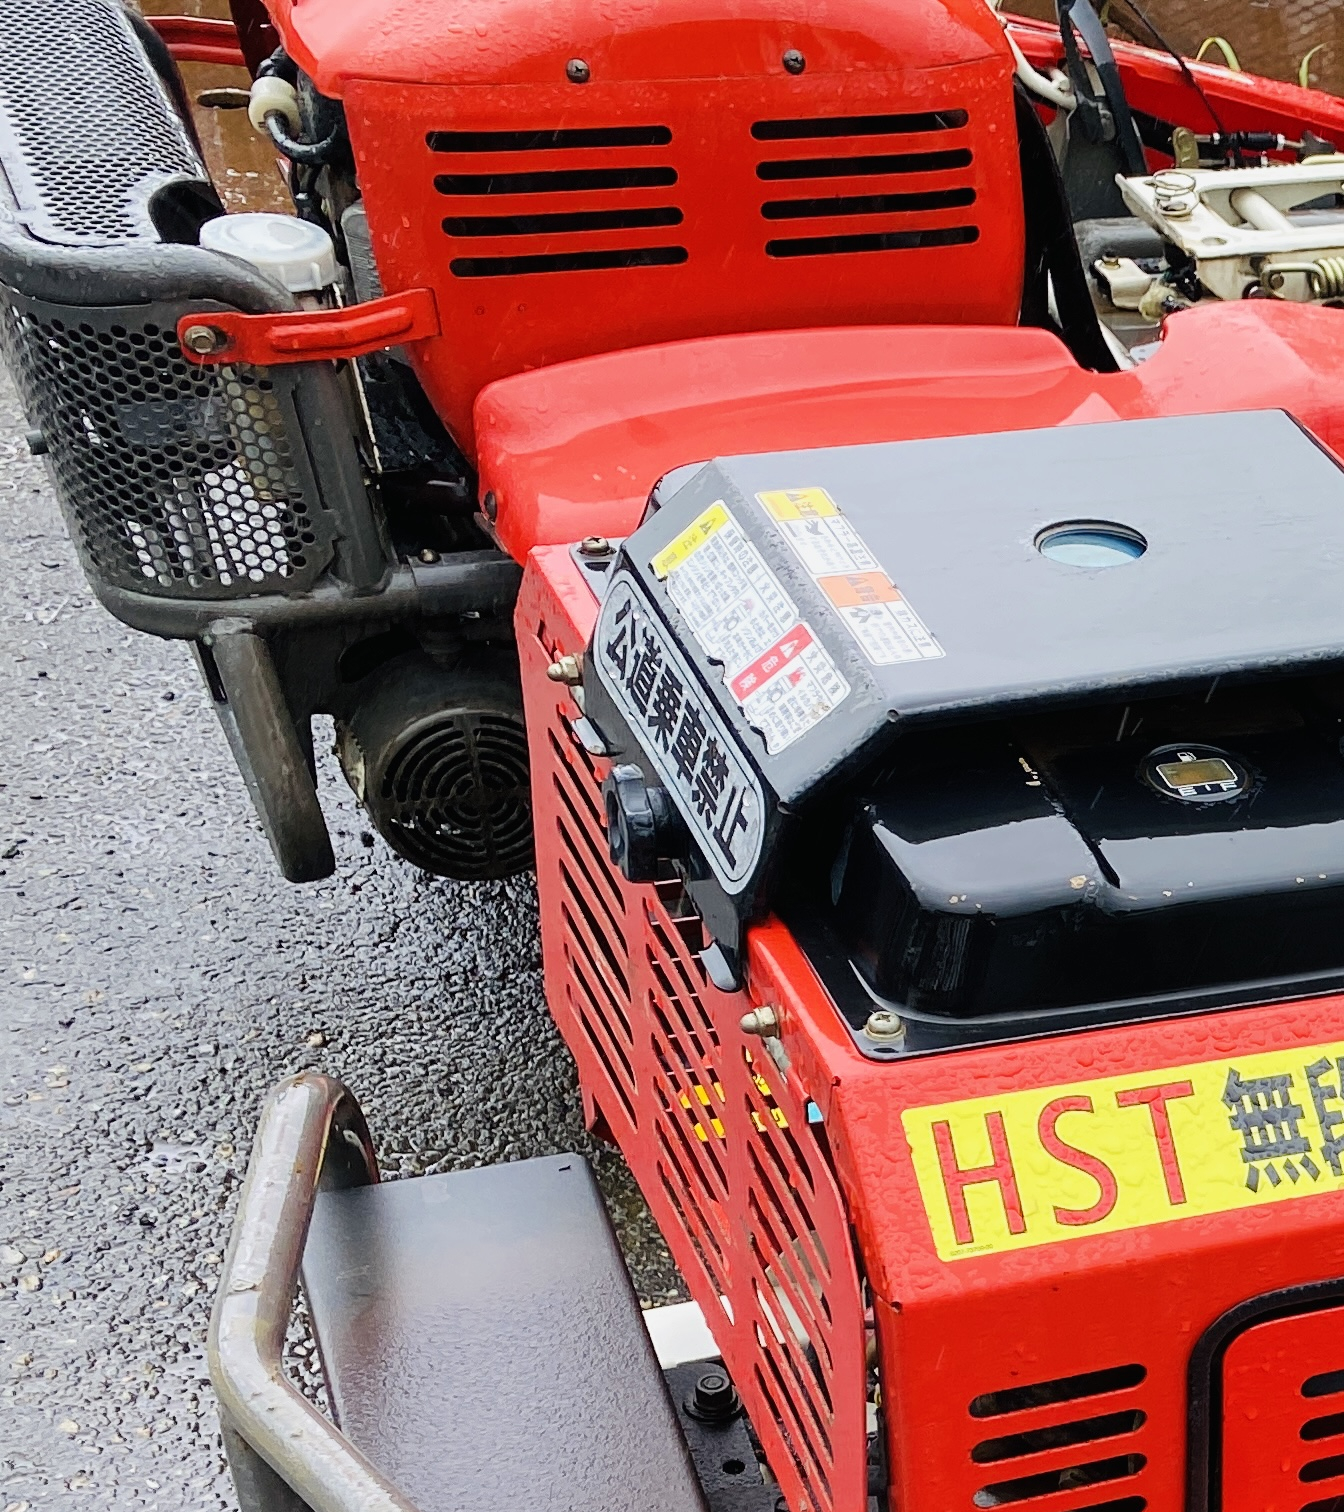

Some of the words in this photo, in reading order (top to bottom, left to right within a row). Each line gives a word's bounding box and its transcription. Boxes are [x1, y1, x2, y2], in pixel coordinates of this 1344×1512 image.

[606, 599, 748, 870] 公道乗車禁止
[930, 1080, 1195, 1246] HST
